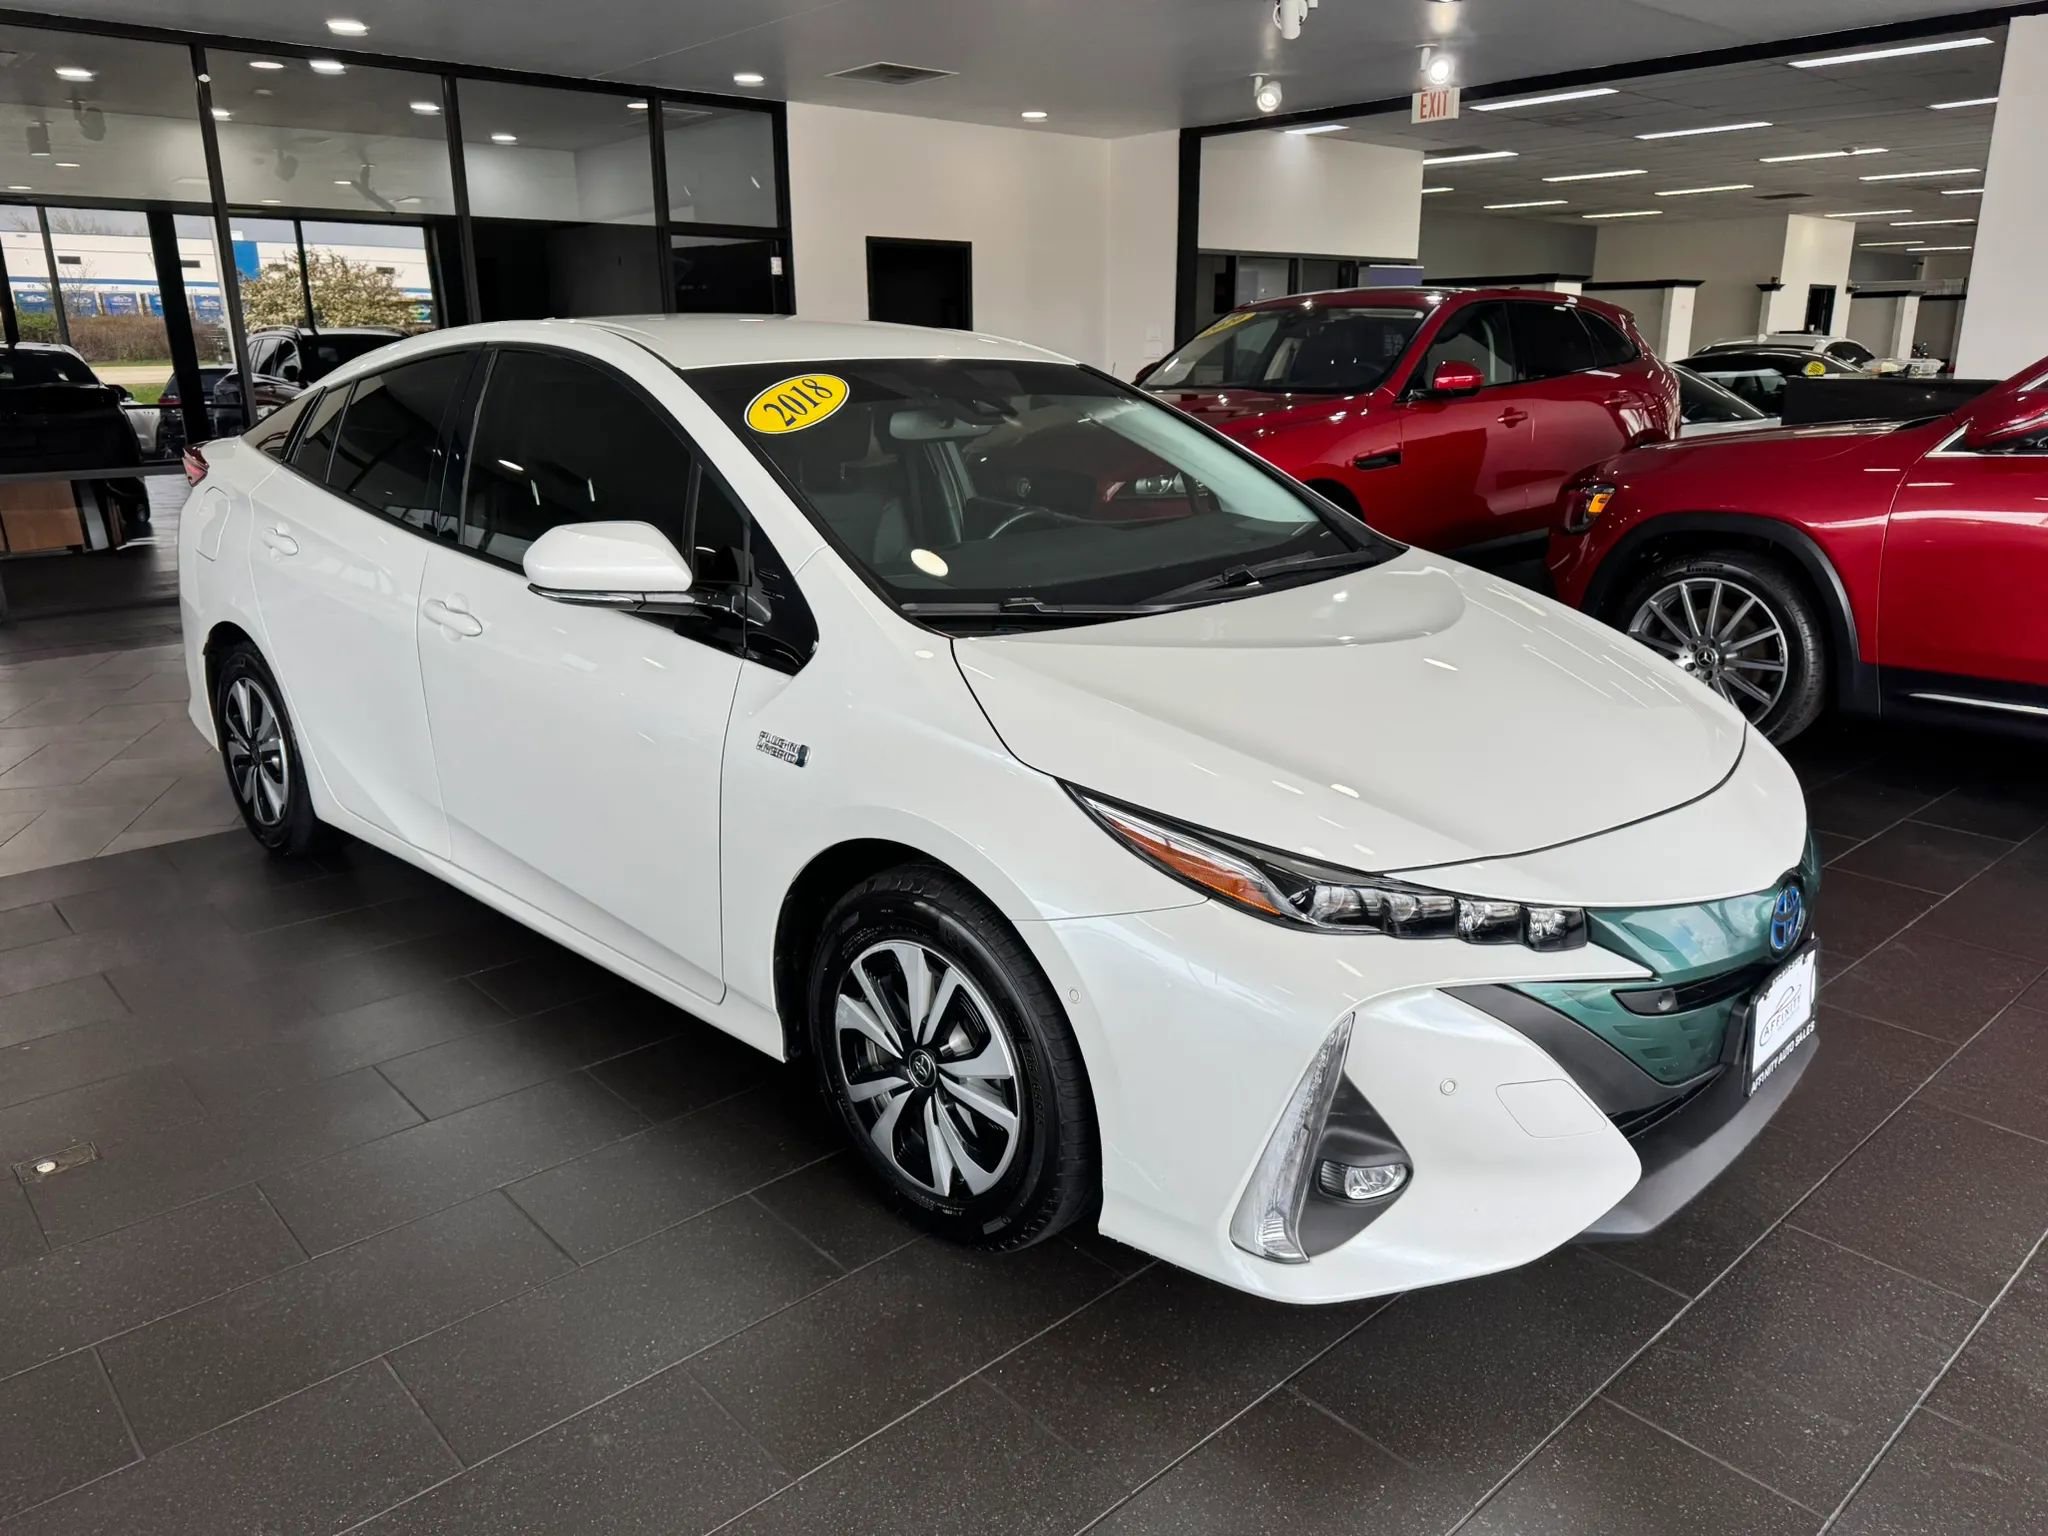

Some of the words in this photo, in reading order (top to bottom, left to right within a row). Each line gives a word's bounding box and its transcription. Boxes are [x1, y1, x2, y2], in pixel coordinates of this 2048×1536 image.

[1420, 90, 1449, 119] EXIT
[763, 378, 833, 427] 2018
[1763, 995, 1801, 1037] AFFINITY
[1748, 1056, 1779, 1097] AFFINITY
[1778, 1040, 1795, 1064] AUTO
[1795, 1020, 1815, 1047] SALES
